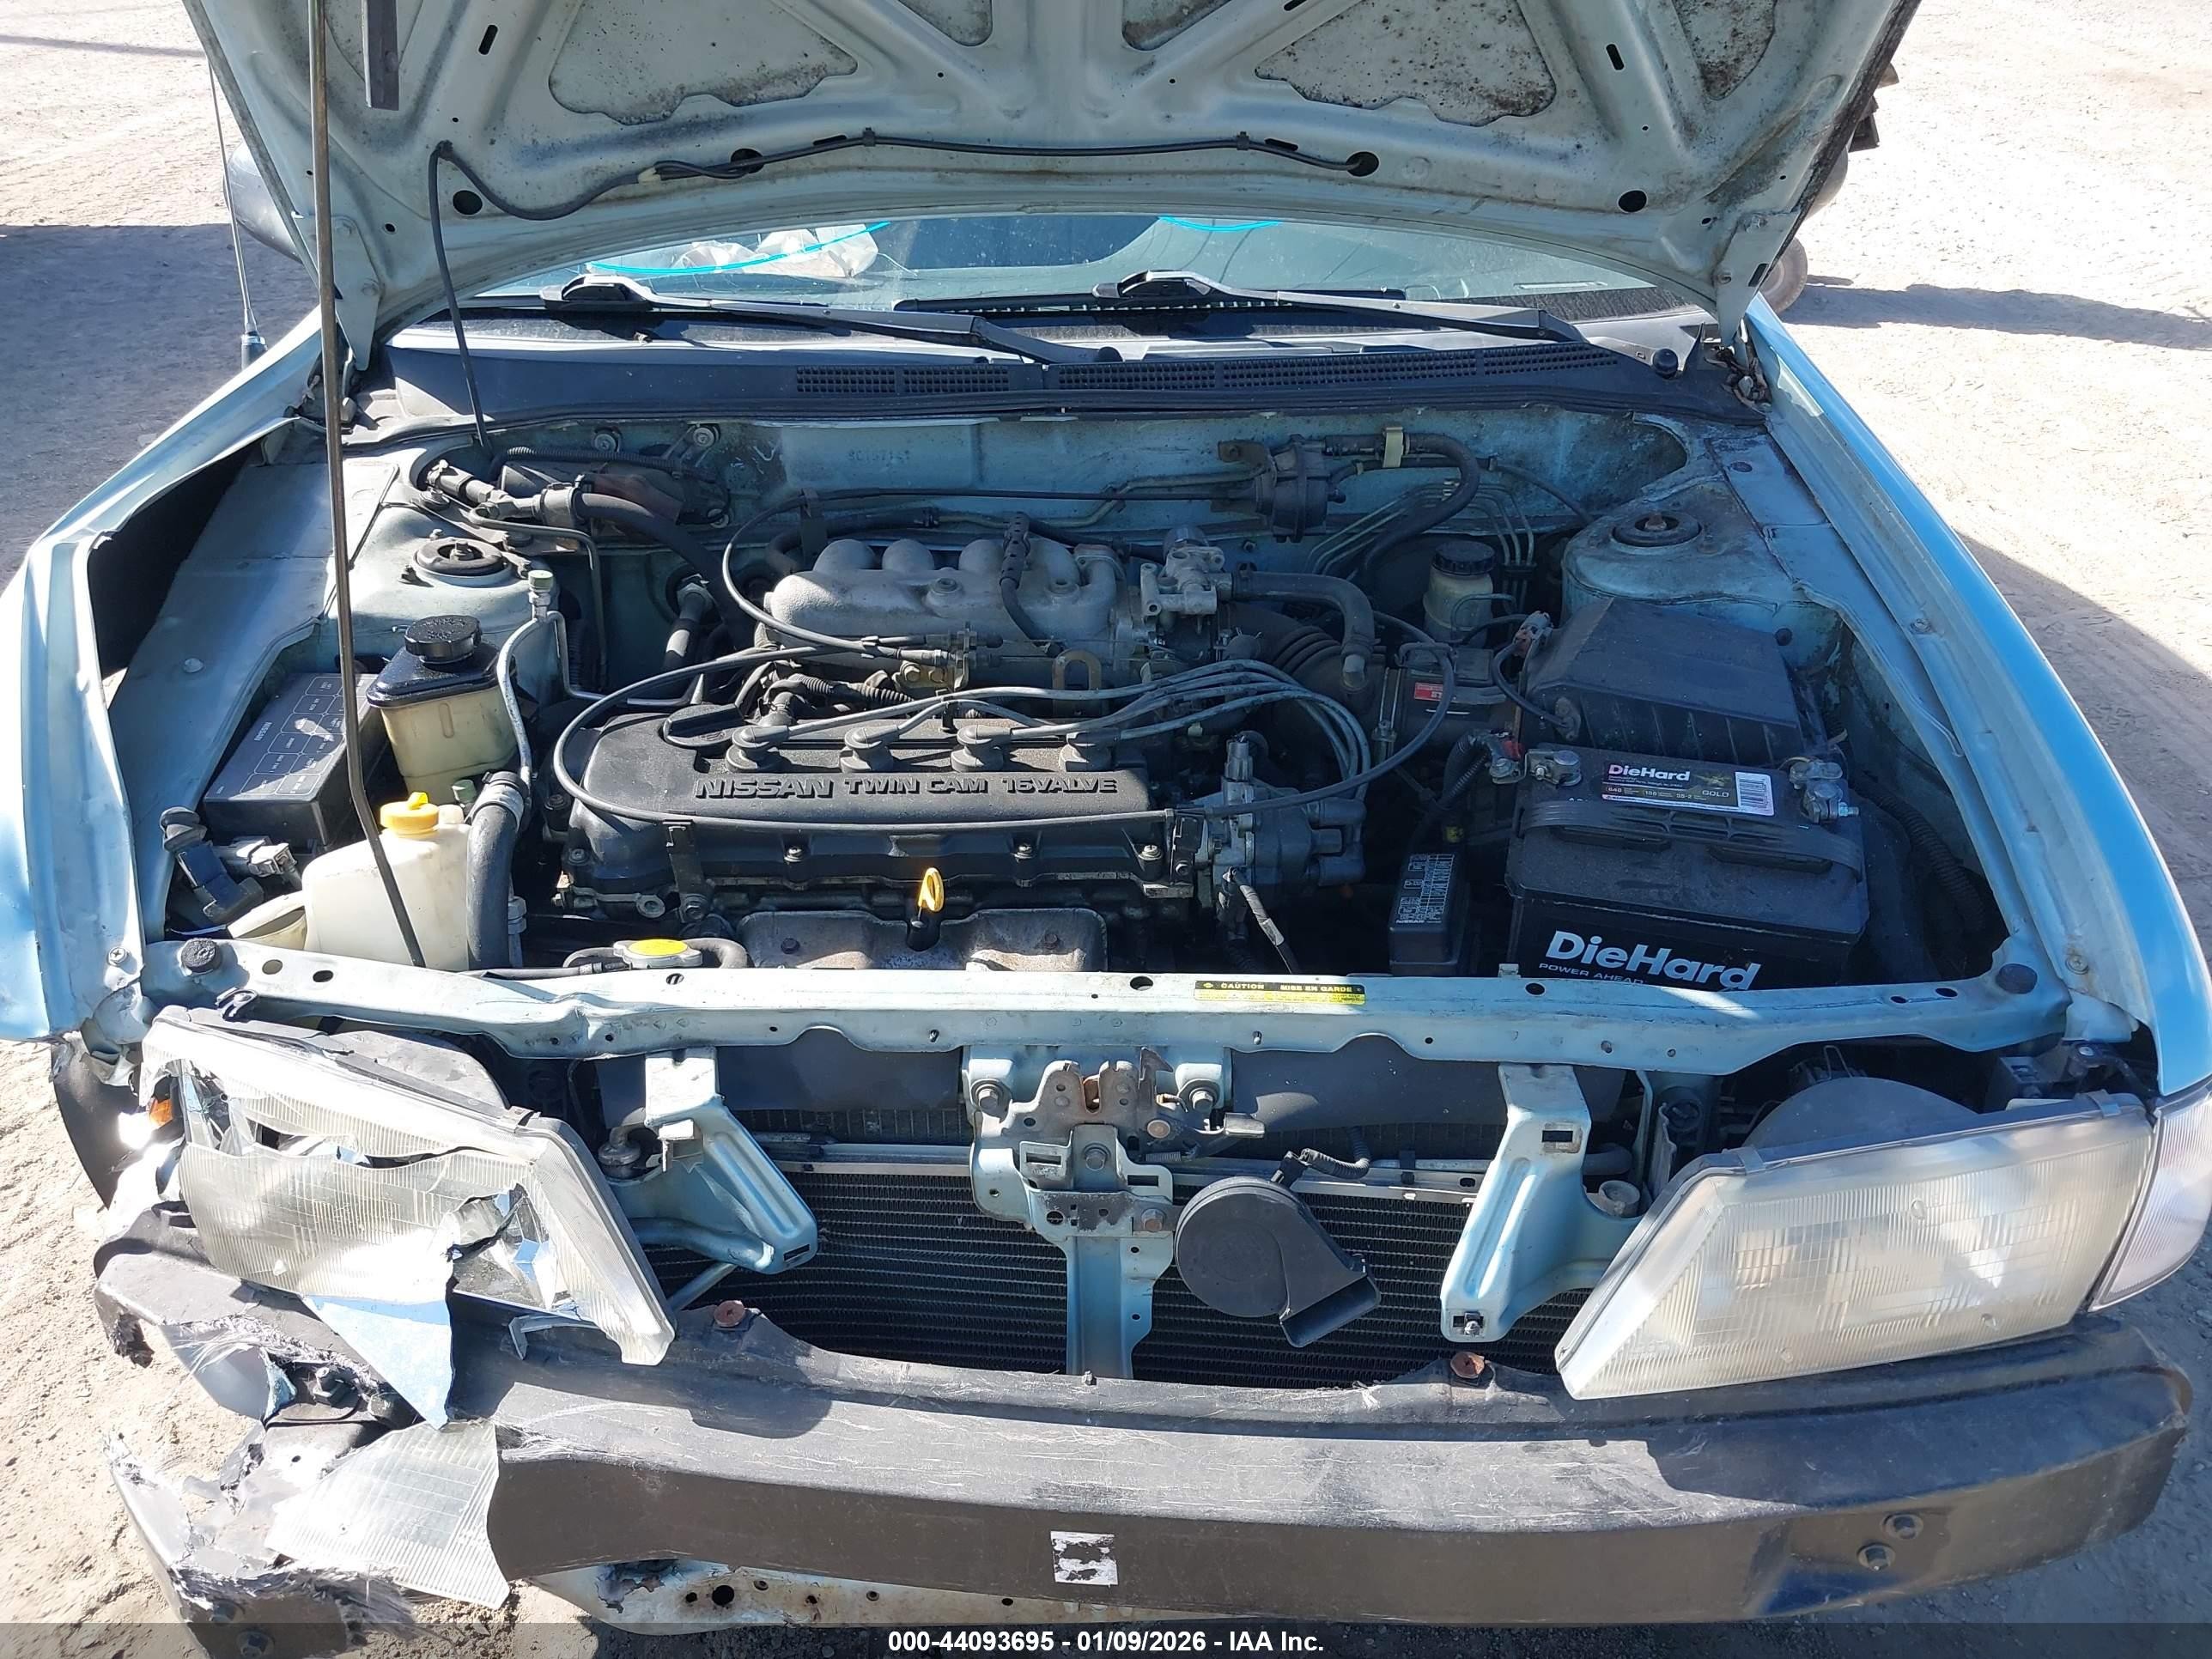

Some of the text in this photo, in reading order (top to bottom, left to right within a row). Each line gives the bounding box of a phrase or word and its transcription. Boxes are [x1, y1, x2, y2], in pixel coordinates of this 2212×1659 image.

[254, 722, 272, 741] NISSAN
[1607, 764, 1691, 781] DieHard
[694, 777, 1119, 799] NISSAN TWIN CAM 16VALVE
[1702, 789, 1729, 799] GOLD
[1546, 930, 1761, 990] DieHard
[1539, 963, 1644, 984] POWER AHEAD
[1220, 981, 1265, 990] CAUTION
